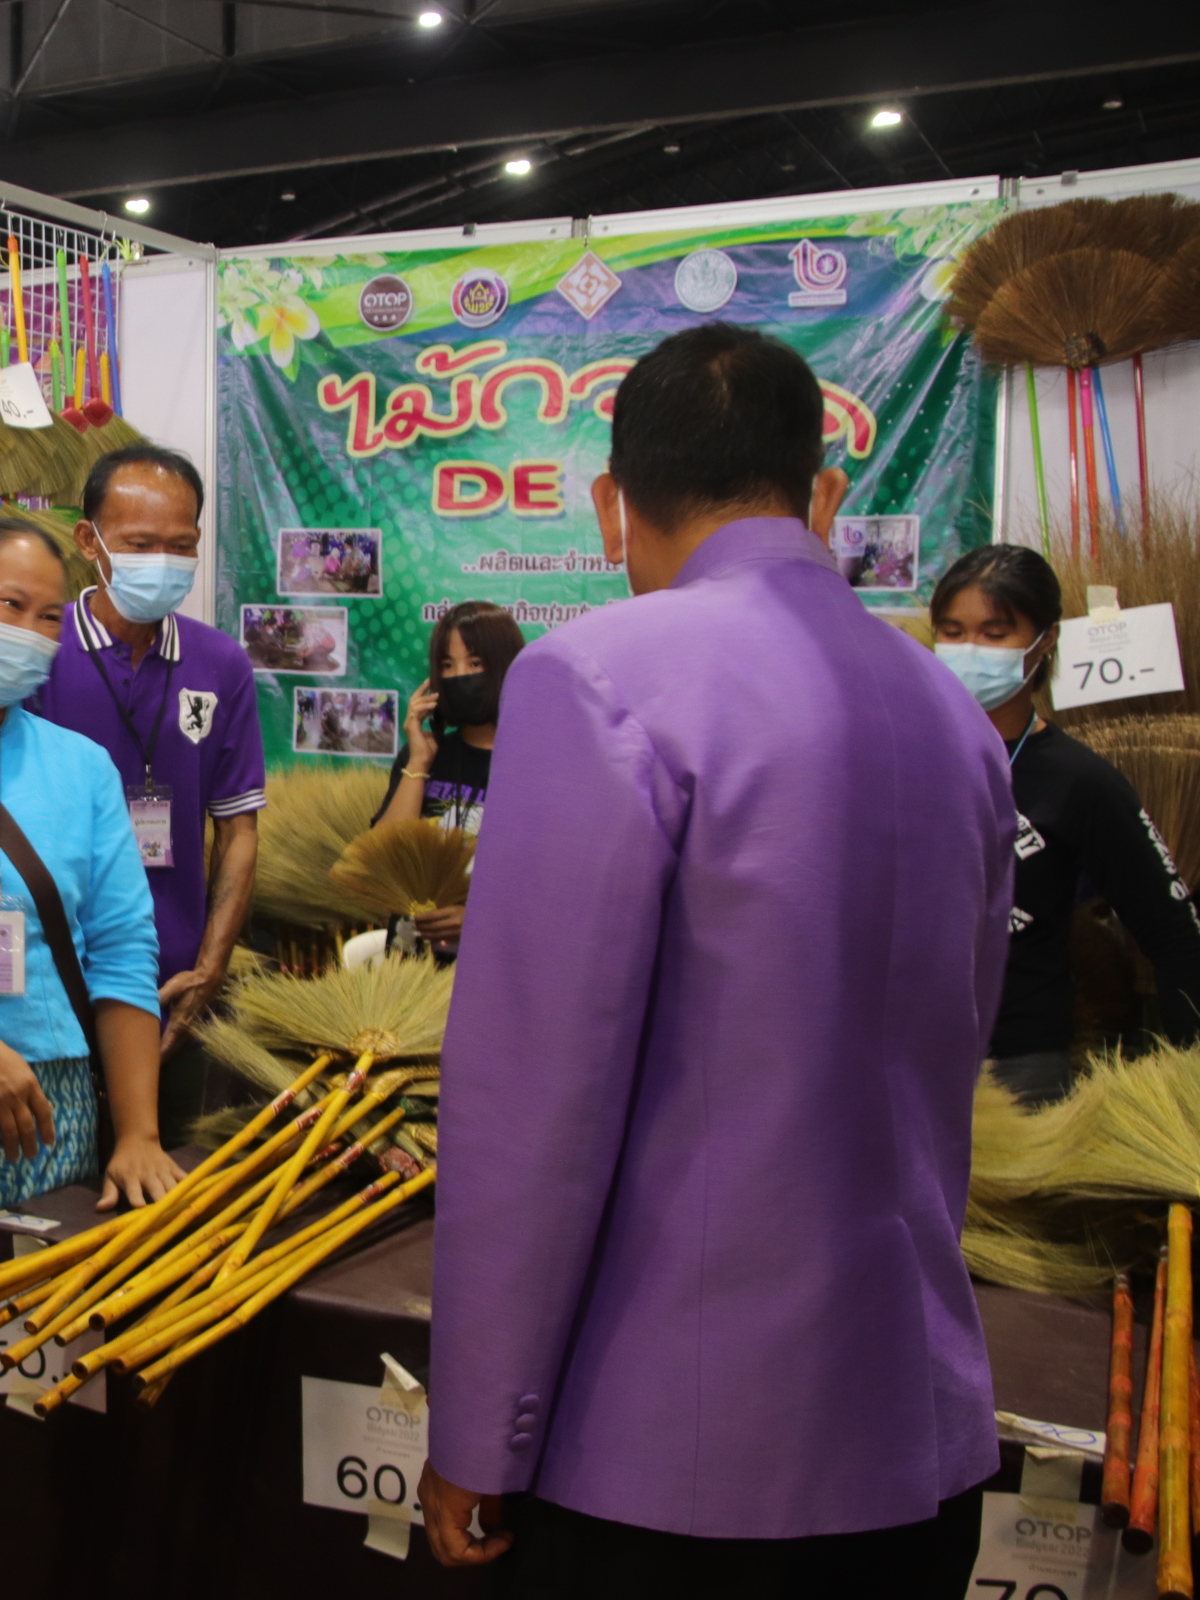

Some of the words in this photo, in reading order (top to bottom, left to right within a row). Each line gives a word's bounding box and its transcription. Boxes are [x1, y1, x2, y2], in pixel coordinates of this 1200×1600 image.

[363, 291, 408, 308] OTOP
[0, 399, 35, 420] 40.-
[1088, 621, 1128, 638] OTOP
[1072, 657, 1155, 691] 70.-
[365, 1405, 422, 1429] OTOP
[1014, 1518, 1093, 1544] OTOP
